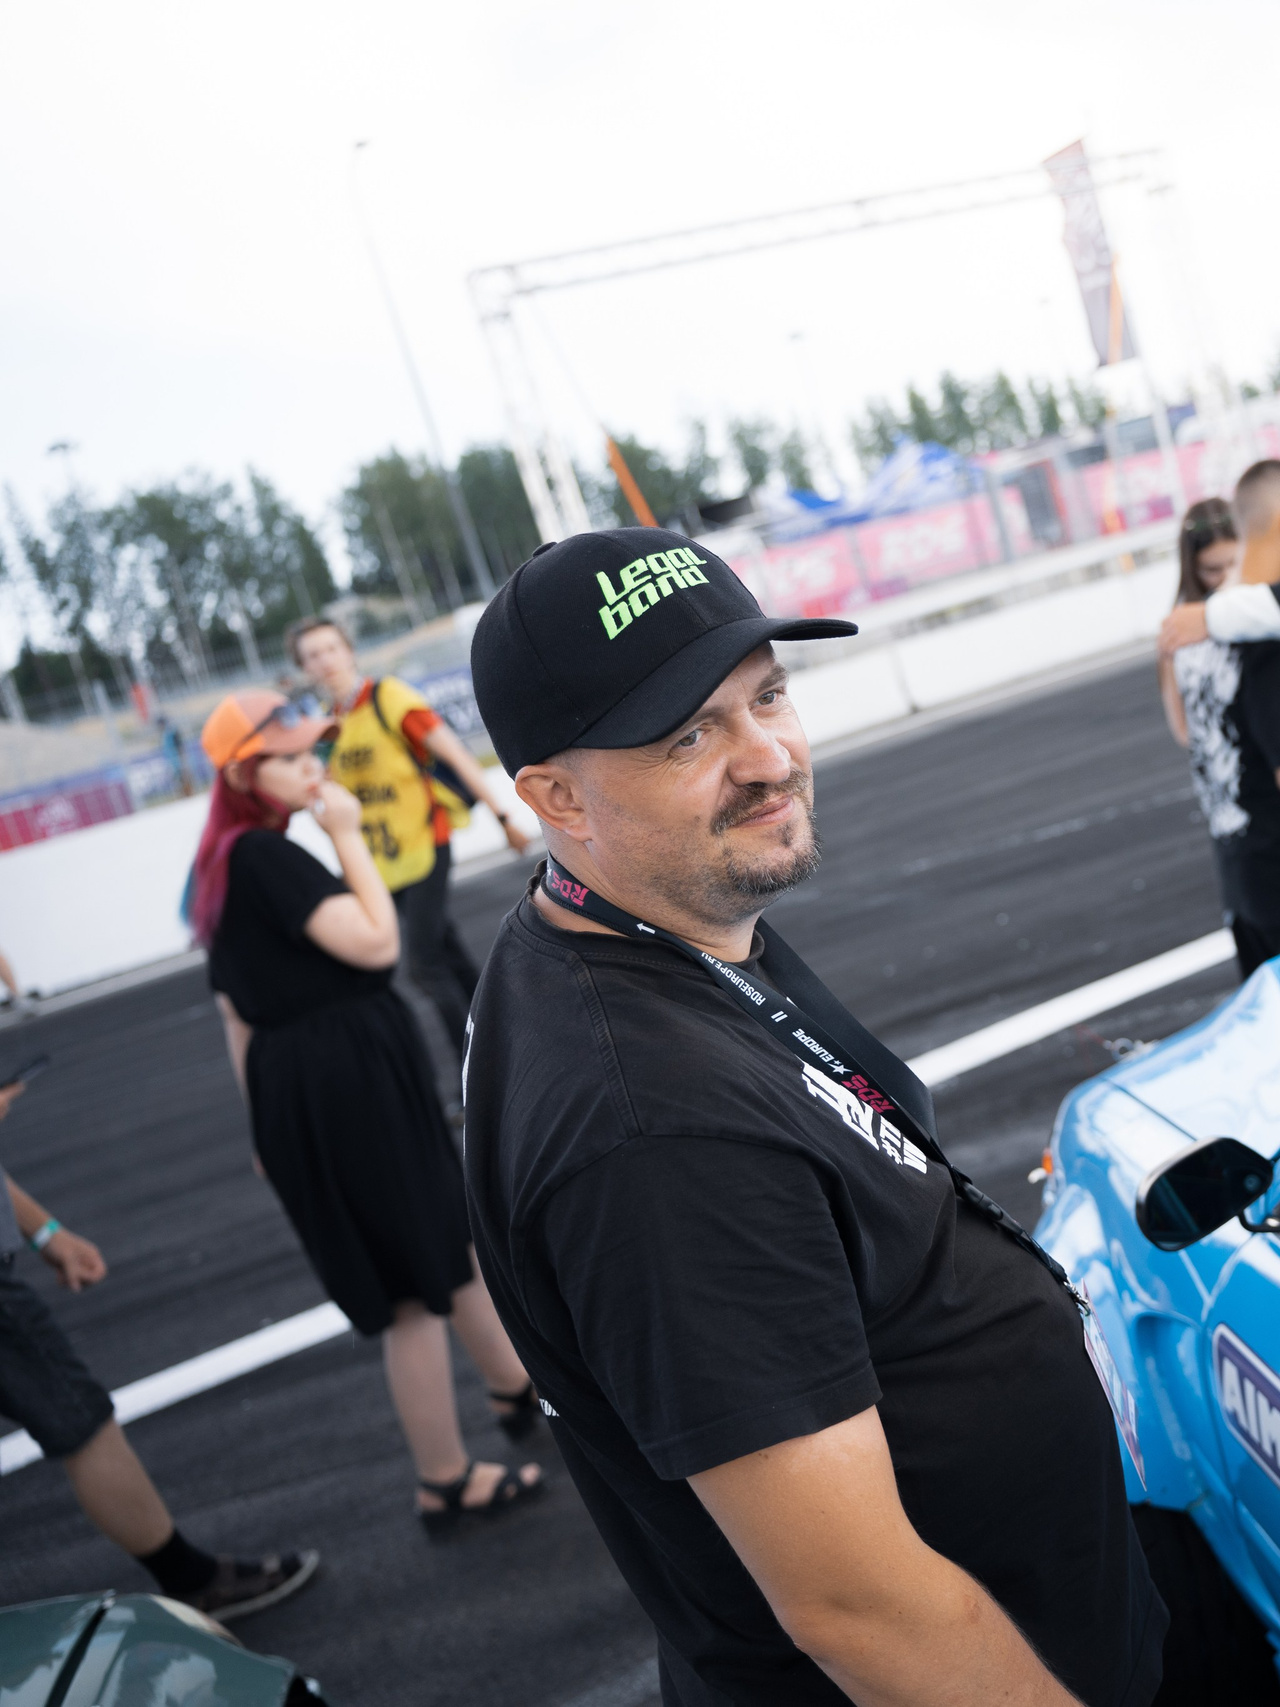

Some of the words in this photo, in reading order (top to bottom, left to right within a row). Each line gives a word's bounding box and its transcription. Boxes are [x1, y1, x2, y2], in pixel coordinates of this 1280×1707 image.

[551, 869, 590, 907] RDS
[792, 1028, 835, 1063] EUROPE
[841, 1074, 896, 1114] RDS
